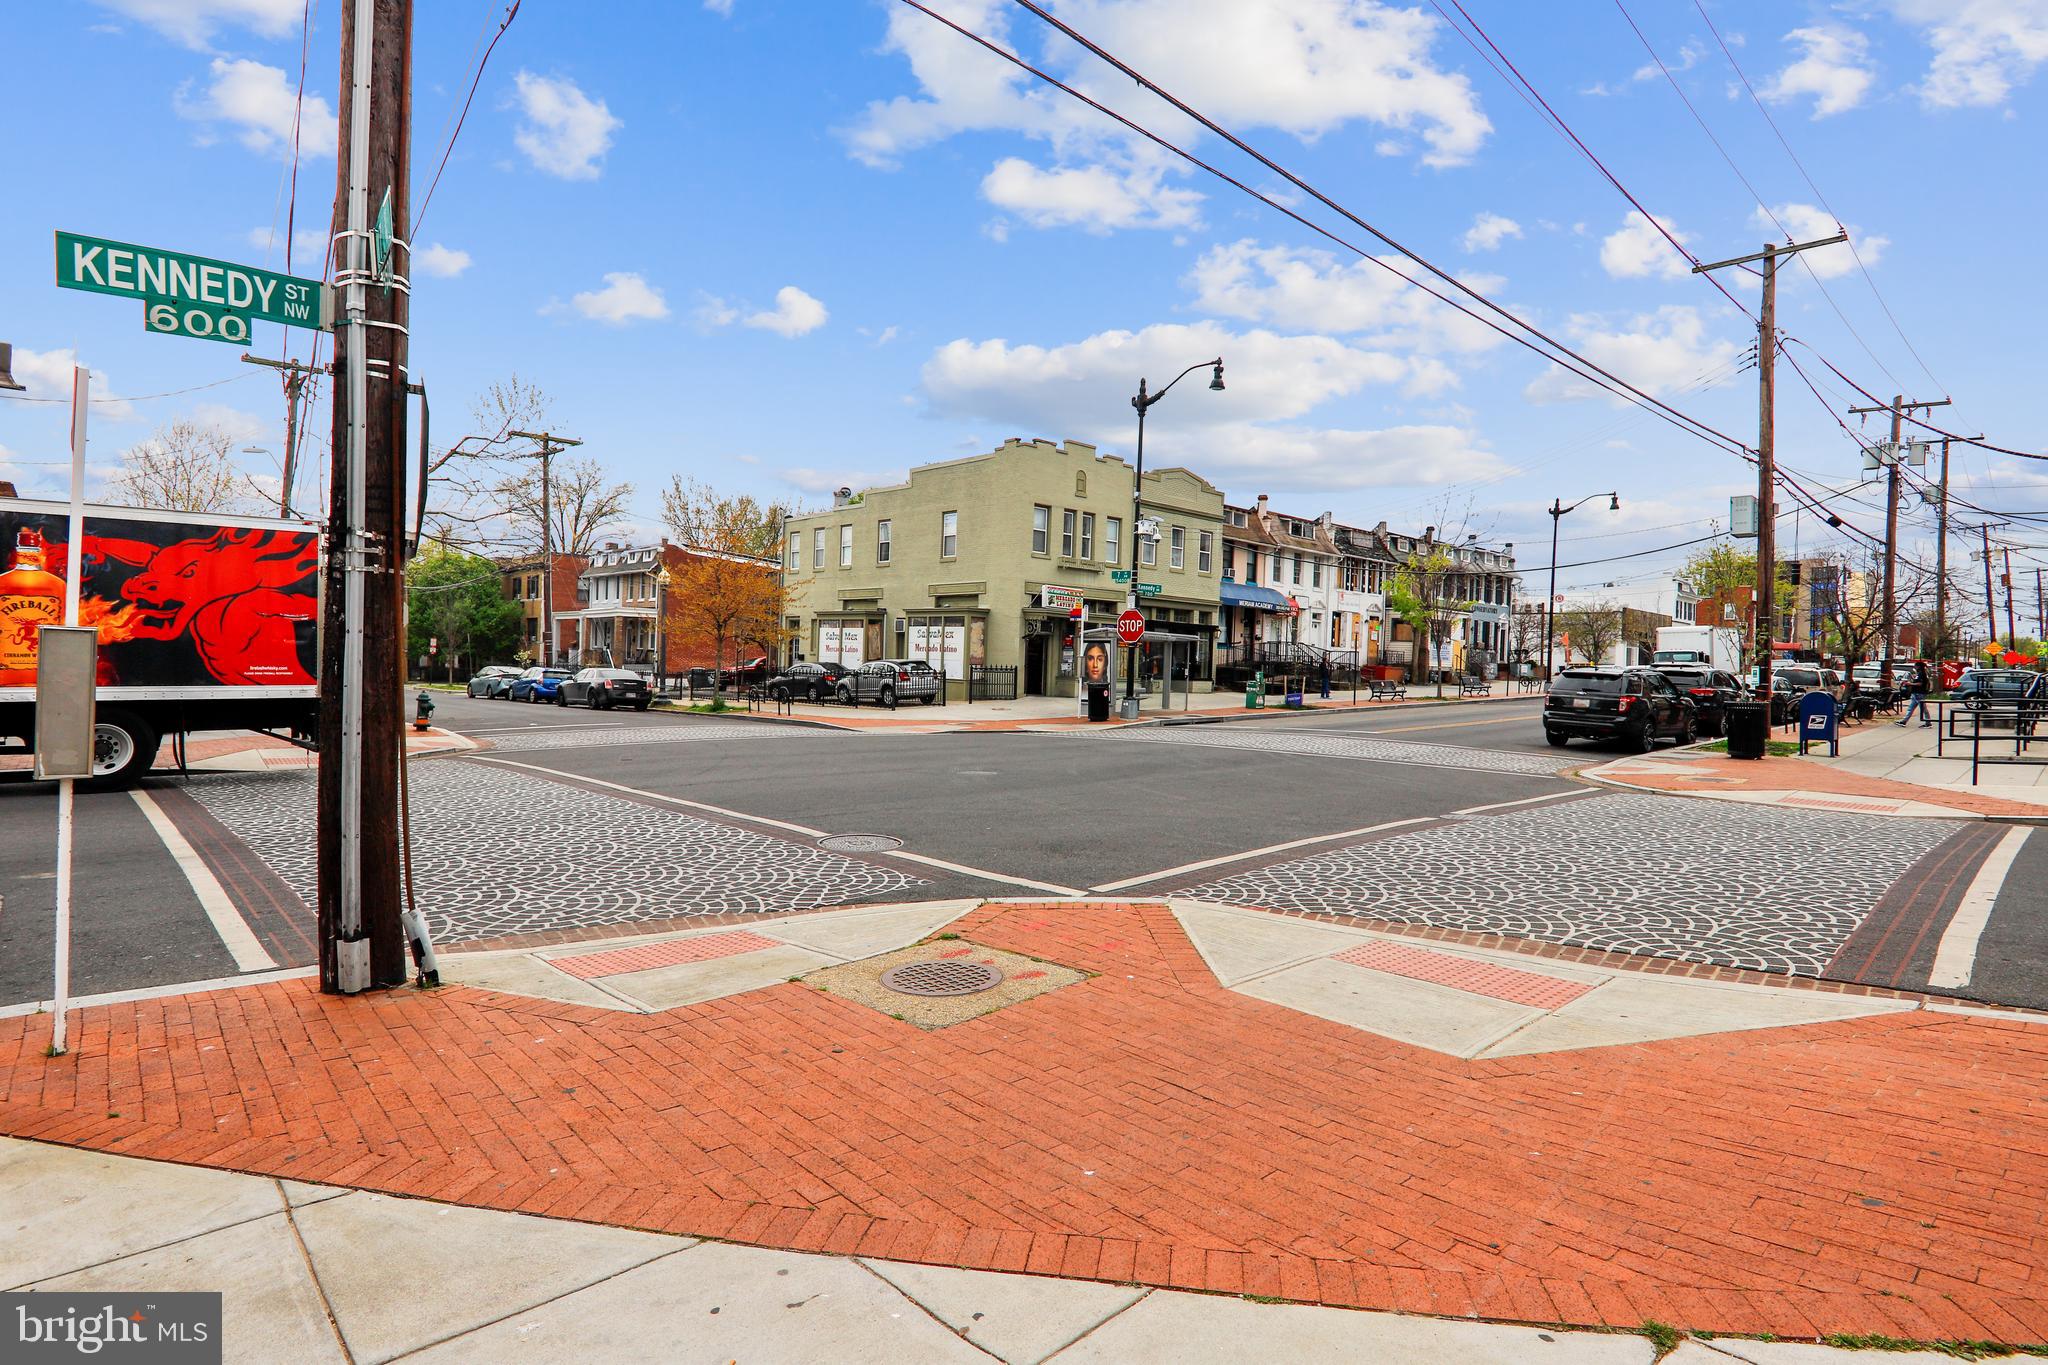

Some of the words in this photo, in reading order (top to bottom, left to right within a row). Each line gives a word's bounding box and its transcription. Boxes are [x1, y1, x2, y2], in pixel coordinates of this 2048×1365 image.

[74, 242, 277, 313] KENNEDY
[284, 283, 310, 302] ST
[284, 300, 310, 321] NW
[149, 304, 249, 342] 600
[1137, 584, 1156, 592] Kennedy
[0, 600, 56, 617] FIREBALL
[1255, 602, 1274, 610] ACADEMY
[1119, 619, 1143, 632] STOP
[844, 645, 859, 653] Latino
